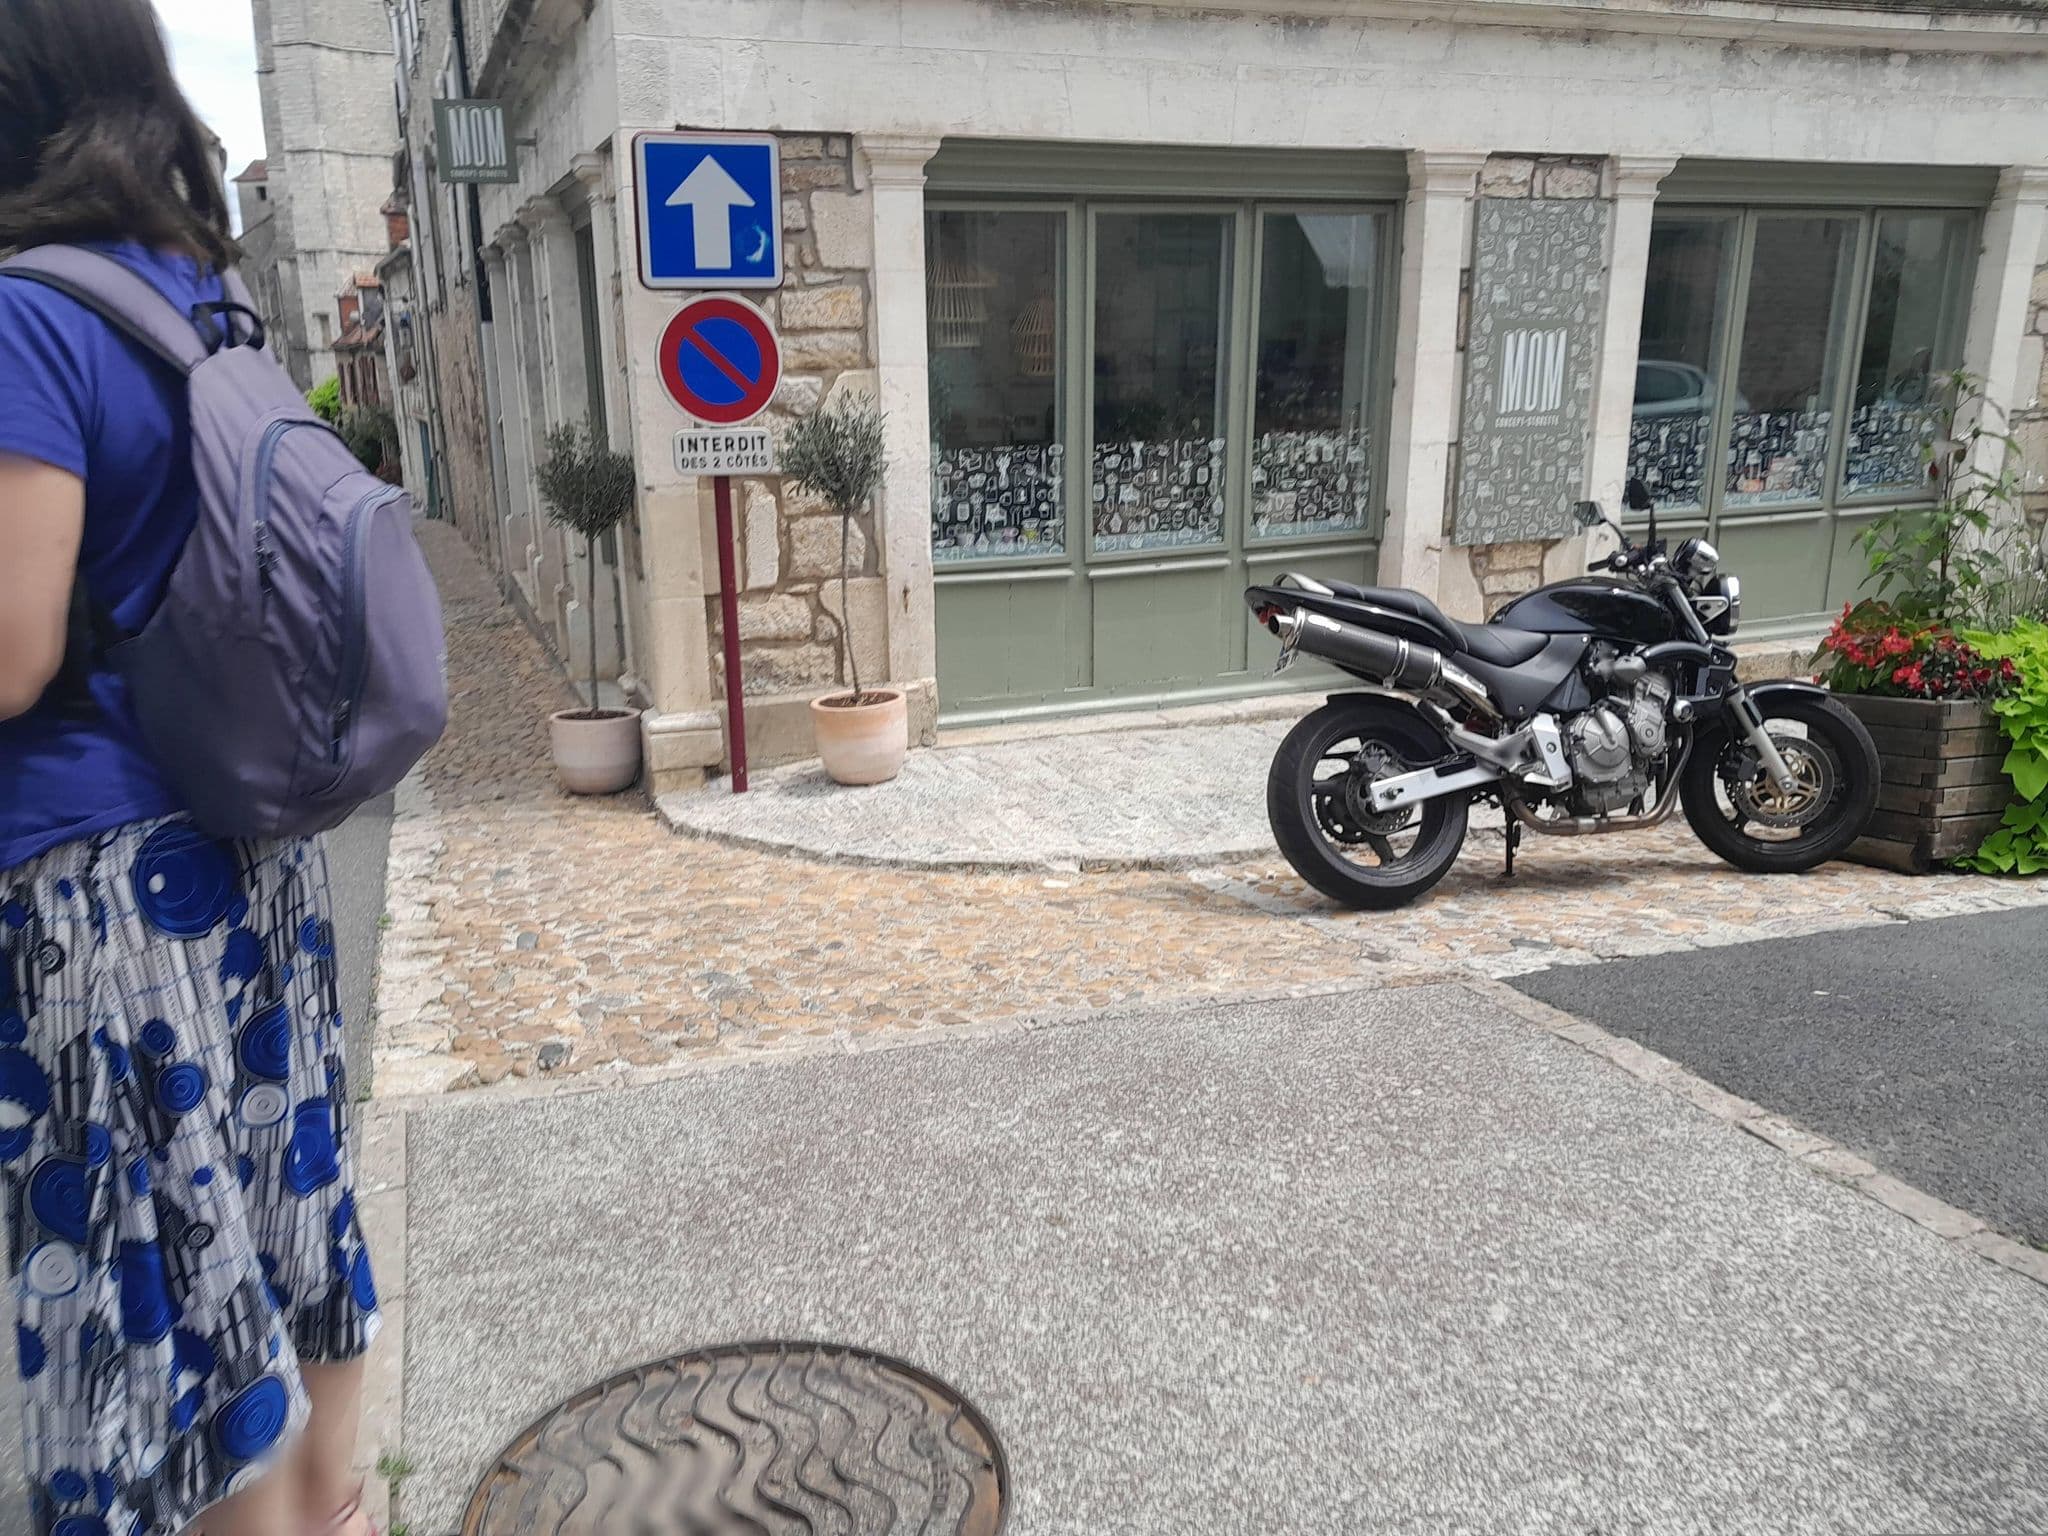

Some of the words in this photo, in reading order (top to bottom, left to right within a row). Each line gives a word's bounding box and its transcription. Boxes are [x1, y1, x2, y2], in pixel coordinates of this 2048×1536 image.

[446, 106, 507, 168] MOM
[1499, 328, 1568, 414] MOM
[680, 436, 766, 453] INTERDIT
[681, 456, 708, 469] DES
[713, 456, 721, 469] 2
